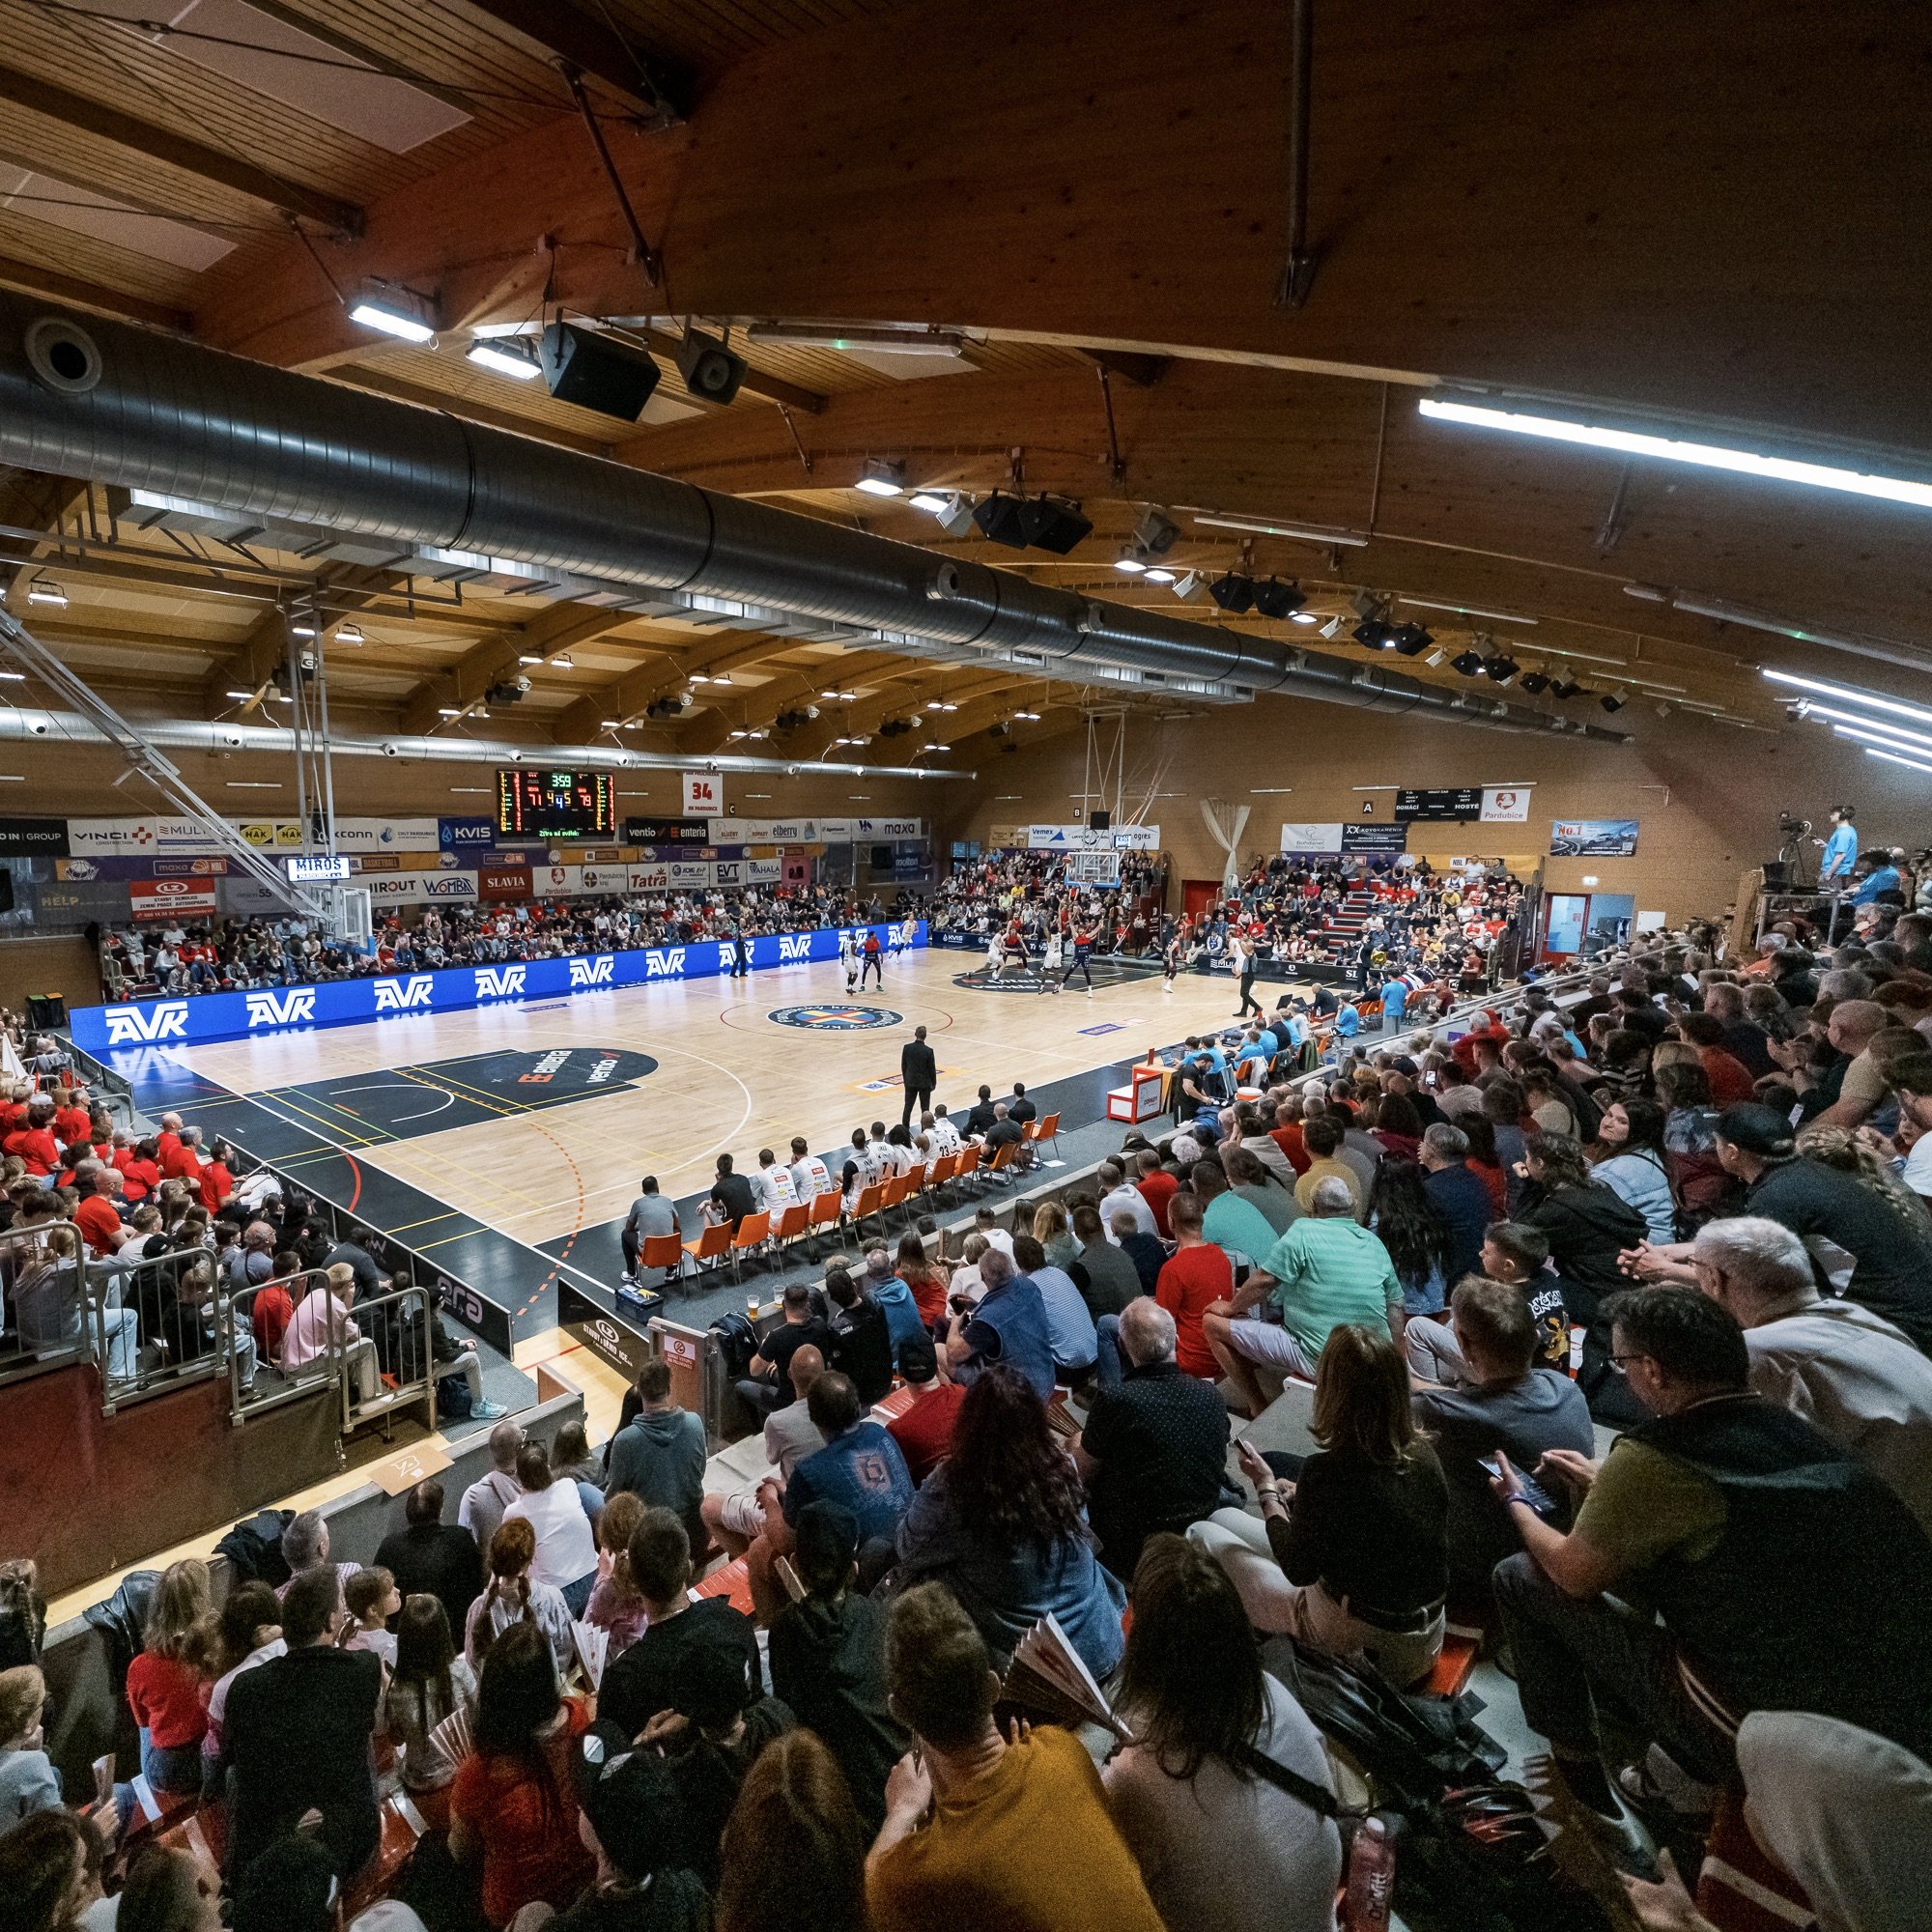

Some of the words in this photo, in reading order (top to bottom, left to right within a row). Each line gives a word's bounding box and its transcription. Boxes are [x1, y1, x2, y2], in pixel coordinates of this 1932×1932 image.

[553, 776, 571, 787] 3:59
[692, 782, 712, 800] 34
[529, 794, 541, 806] 71
[547, 792, 554, 804] 4
[556, 798, 562, 809] 4
[564, 792, 571, 804] 5
[580, 795, 591, 806] 79
[455, 827, 491, 838] KVIS
[629, 827, 656, 837] ventio
[680, 827, 706, 838] enteria
[773, 825, 797, 838] elberry
[885, 823, 915, 835] maxa
[1558, 826, 1582, 835] No.1
[297, 858, 341, 870] MIROS
[896, 858, 918, 867] molten
[717, 865, 739, 877] EVT
[369, 880, 416, 892] JIROUT
[487, 877, 526, 888] SLAVIA
[631, 875, 667, 888] Tatra
[259, 889, 272, 897] 55
[42, 896, 78, 906] HELP
[779, 934, 811, 960] AVK
[646, 948, 686, 977] AVK
[570, 956, 613, 987] AVK
[475, 966, 526, 998] AVK
[374, 976, 433, 1010] AVK
[246, 988, 315, 1027] AVK
[105, 1001, 188, 1045] AVK
[532, 1051, 573, 1073] enteria
[586, 1060, 618, 1083] ventio
[952, 1136, 956, 1147] 5
[940, 1146, 949, 1157] 23
[883, 1162, 888, 1175] 7
[601, 1323, 613, 1339] LZ
